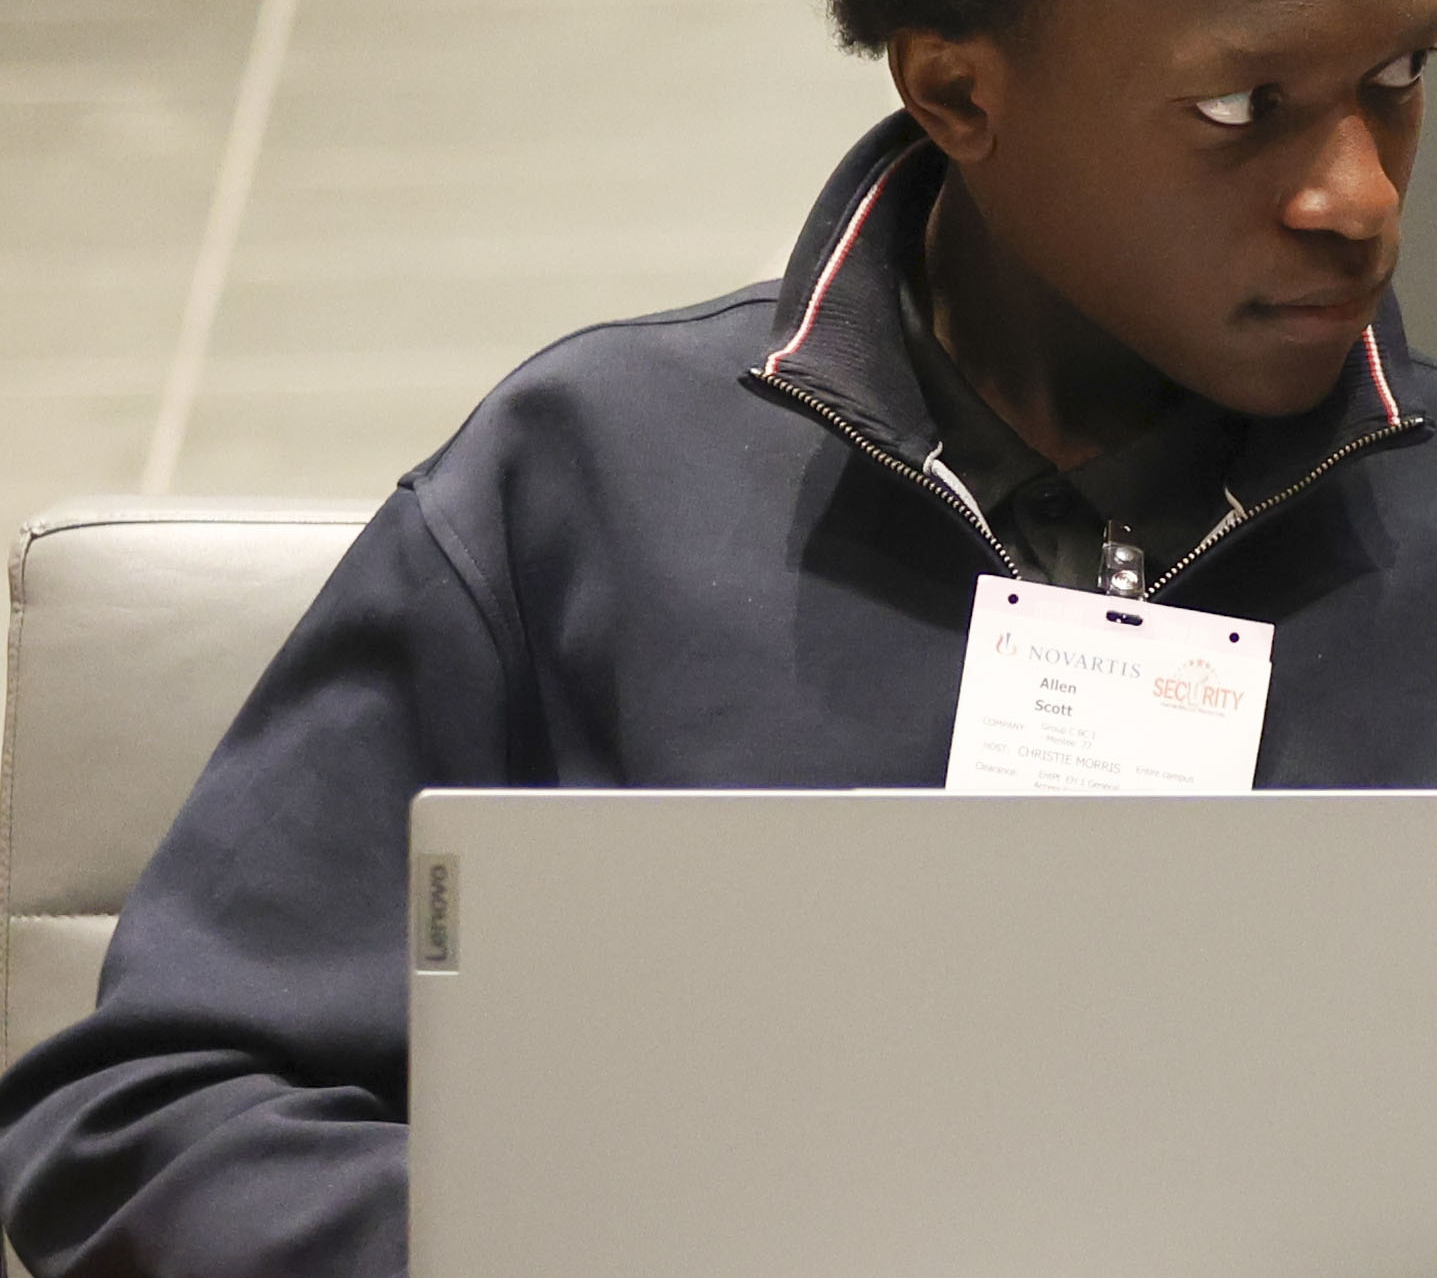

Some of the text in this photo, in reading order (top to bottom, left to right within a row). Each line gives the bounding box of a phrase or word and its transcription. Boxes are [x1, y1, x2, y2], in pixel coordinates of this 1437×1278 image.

[1028, 644, 1143, 679] NOVARTIS
[1039, 677, 1078, 695] Allen
[1034, 698, 1073, 717] Scott
[1017, 745, 1122, 775] CHRISTIE MORRIS
[425, 863, 449, 962] Lenovo
